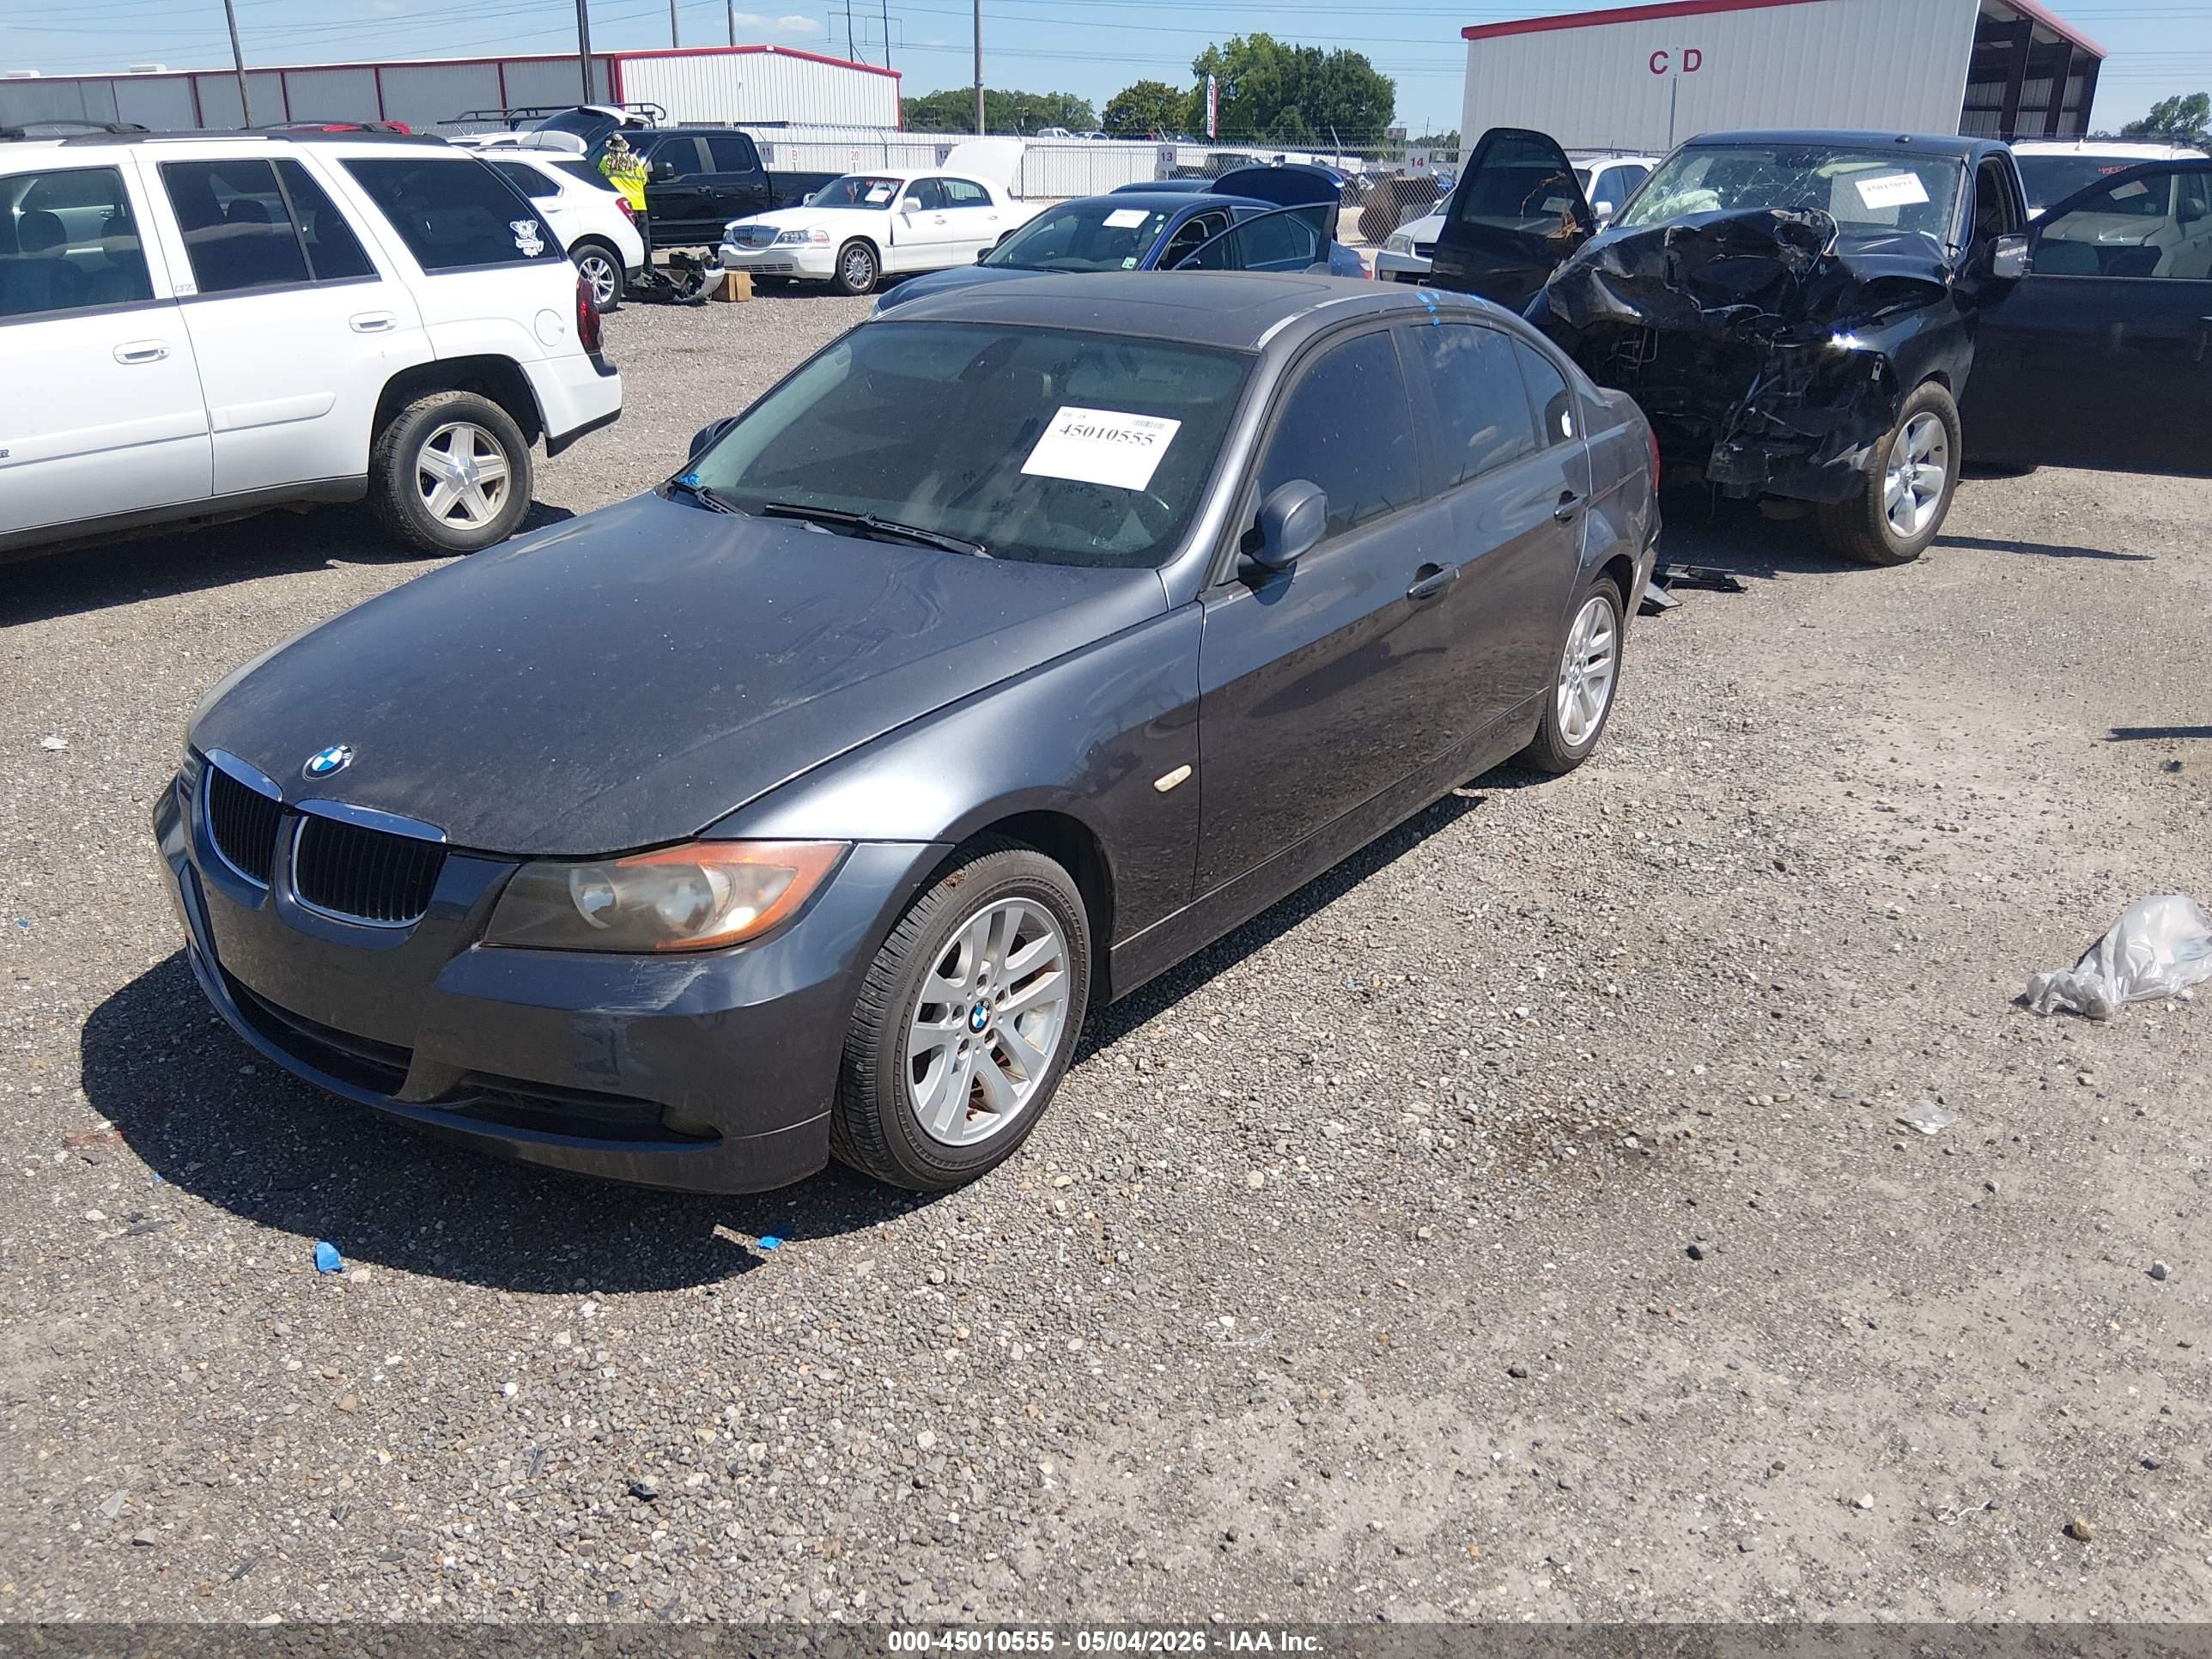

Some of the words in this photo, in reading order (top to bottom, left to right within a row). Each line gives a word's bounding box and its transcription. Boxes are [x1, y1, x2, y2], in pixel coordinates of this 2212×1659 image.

[1649, 51, 1668, 75] C
[1683, 49, 1702, 72] D
[762, 147, 770, 156] 11
[851, 150, 859, 161] 20
[1161, 152, 1173, 162] 13
[1410, 157, 1425, 167] 14
[1060, 422, 1157, 447] 45010555
